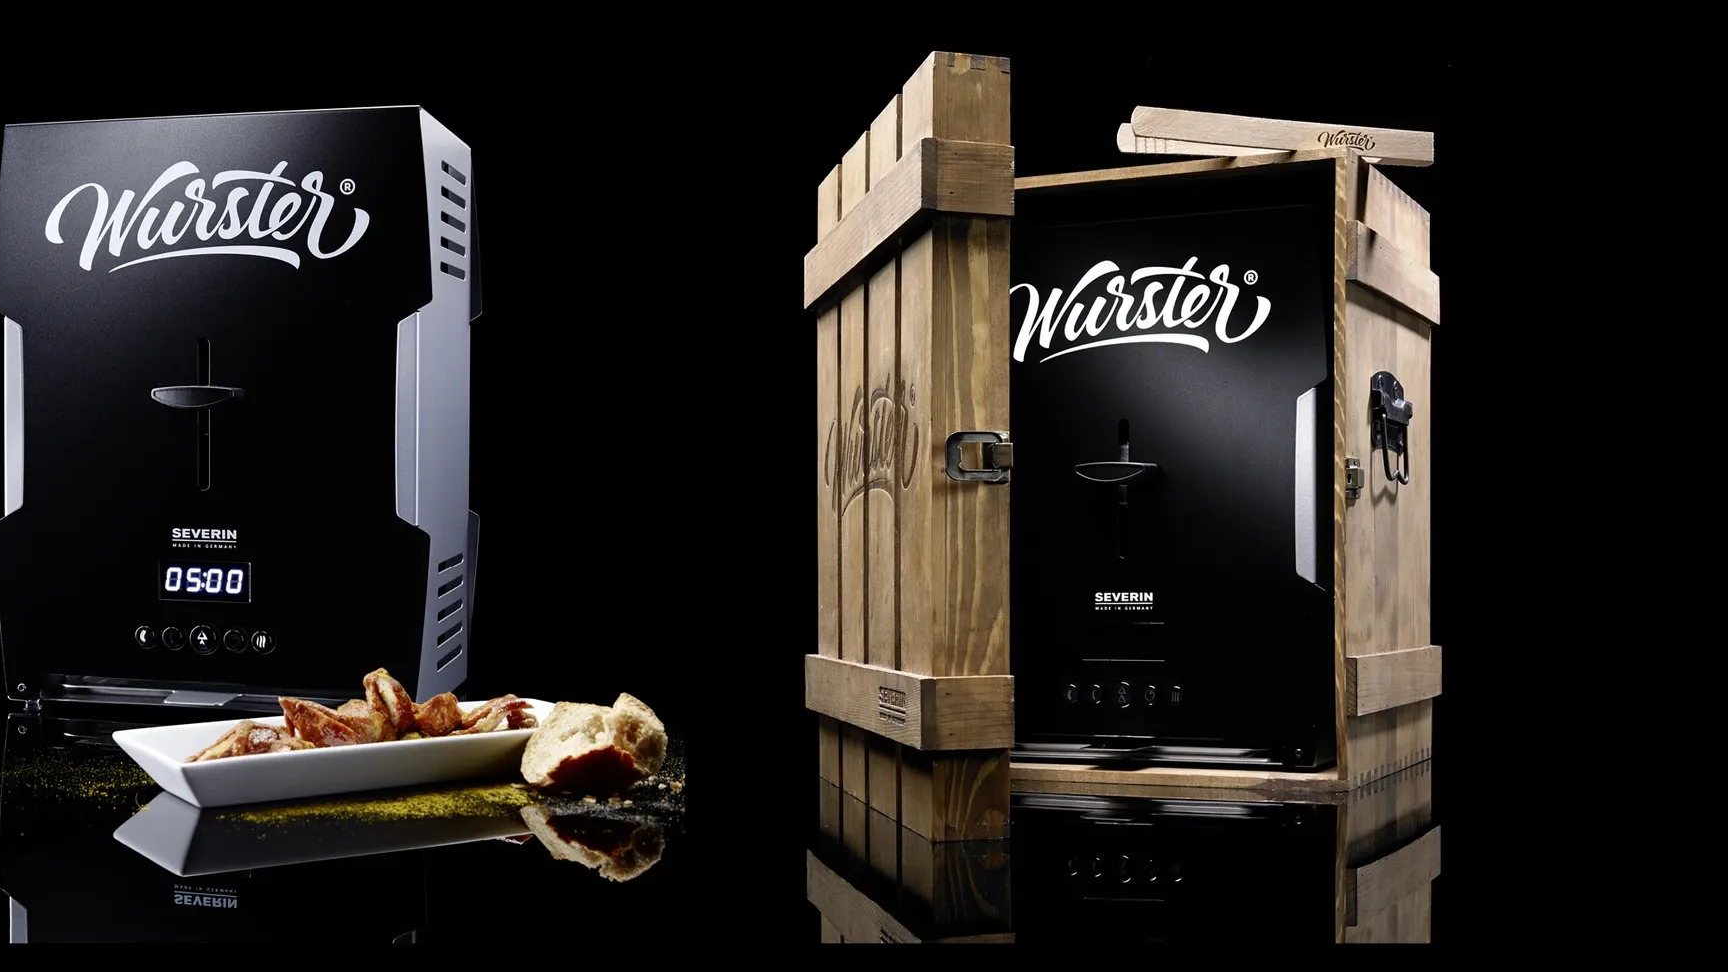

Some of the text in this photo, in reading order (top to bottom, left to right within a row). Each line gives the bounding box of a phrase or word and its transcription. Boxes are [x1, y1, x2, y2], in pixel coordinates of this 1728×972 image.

[172, 528, 237, 539] SEVERIN
[165, 567, 243, 594] 05:00
[1094, 592, 1153, 602] SEVERIN
